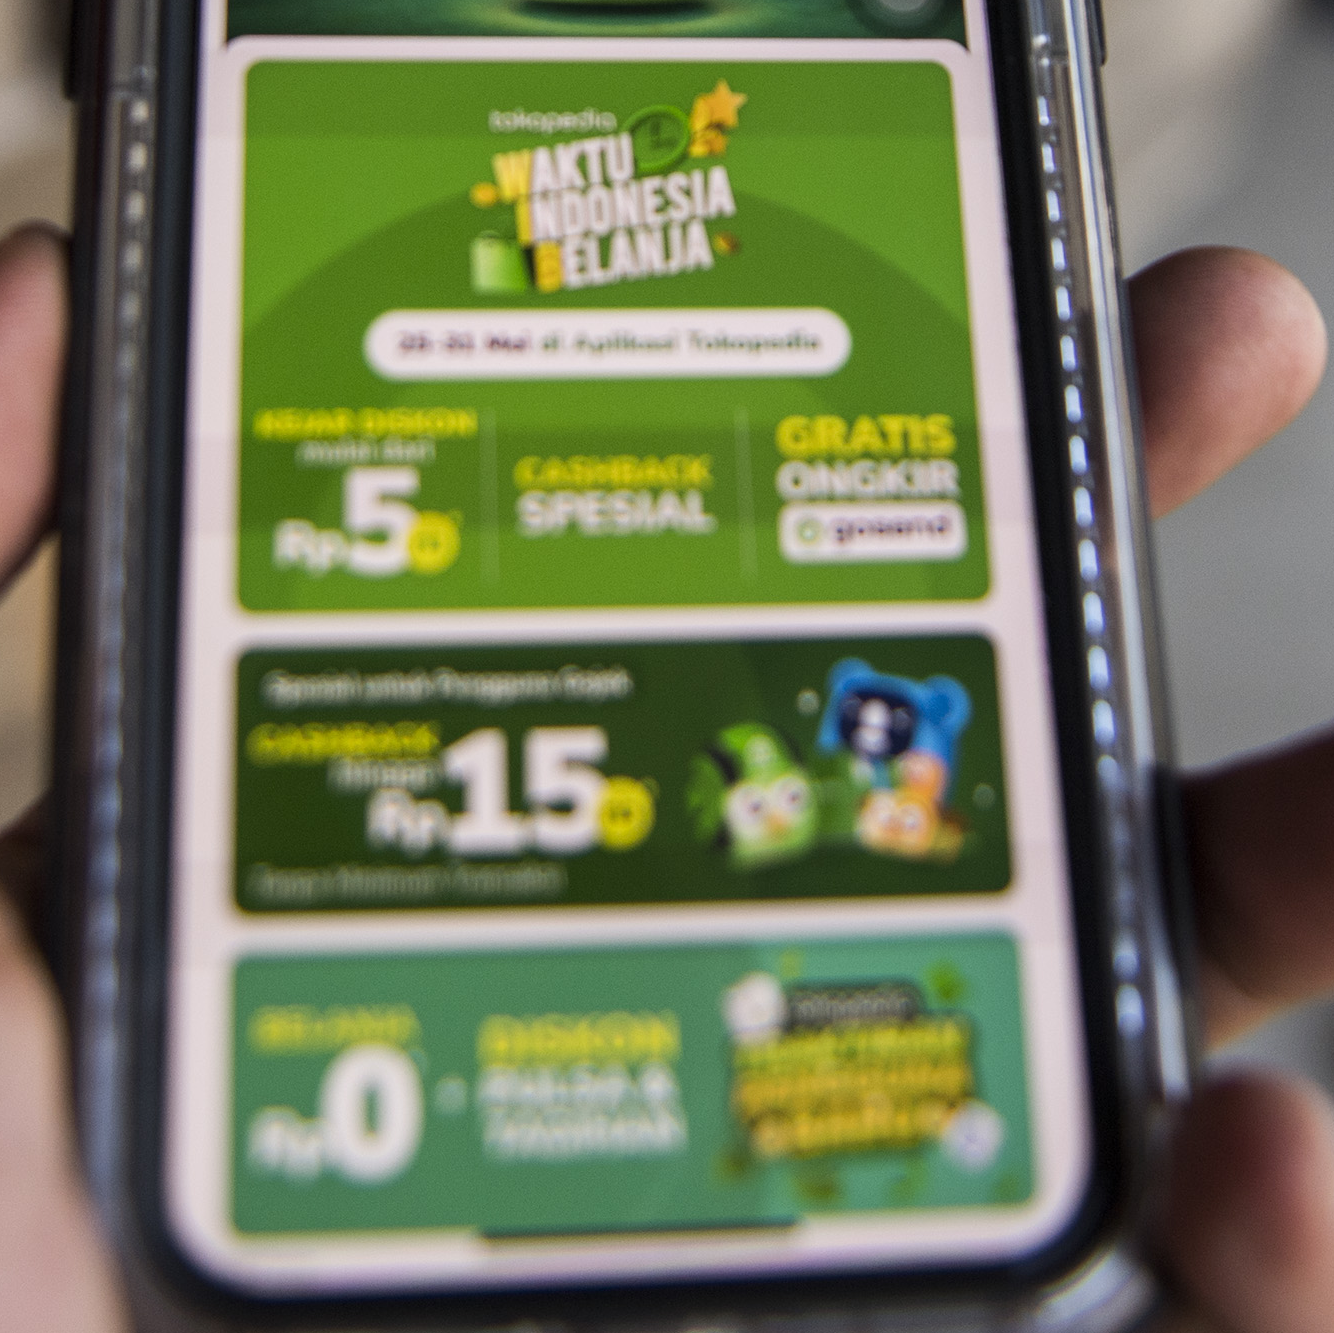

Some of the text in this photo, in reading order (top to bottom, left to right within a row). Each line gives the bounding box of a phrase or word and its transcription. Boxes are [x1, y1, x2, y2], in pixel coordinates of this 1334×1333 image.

[489, 105, 617, 134] tokopedia
[493, 131, 635, 203] WAKTU
[516, 166, 737, 245] INDONESIA
[533, 219, 715, 293] BELANJA
[776, 414, 956, 457] GRATIS
[514, 454, 713, 490] CASHBACK
[776, 459, 959, 499] ONGKIR
[517, 491, 717, 534] SPESIAL
